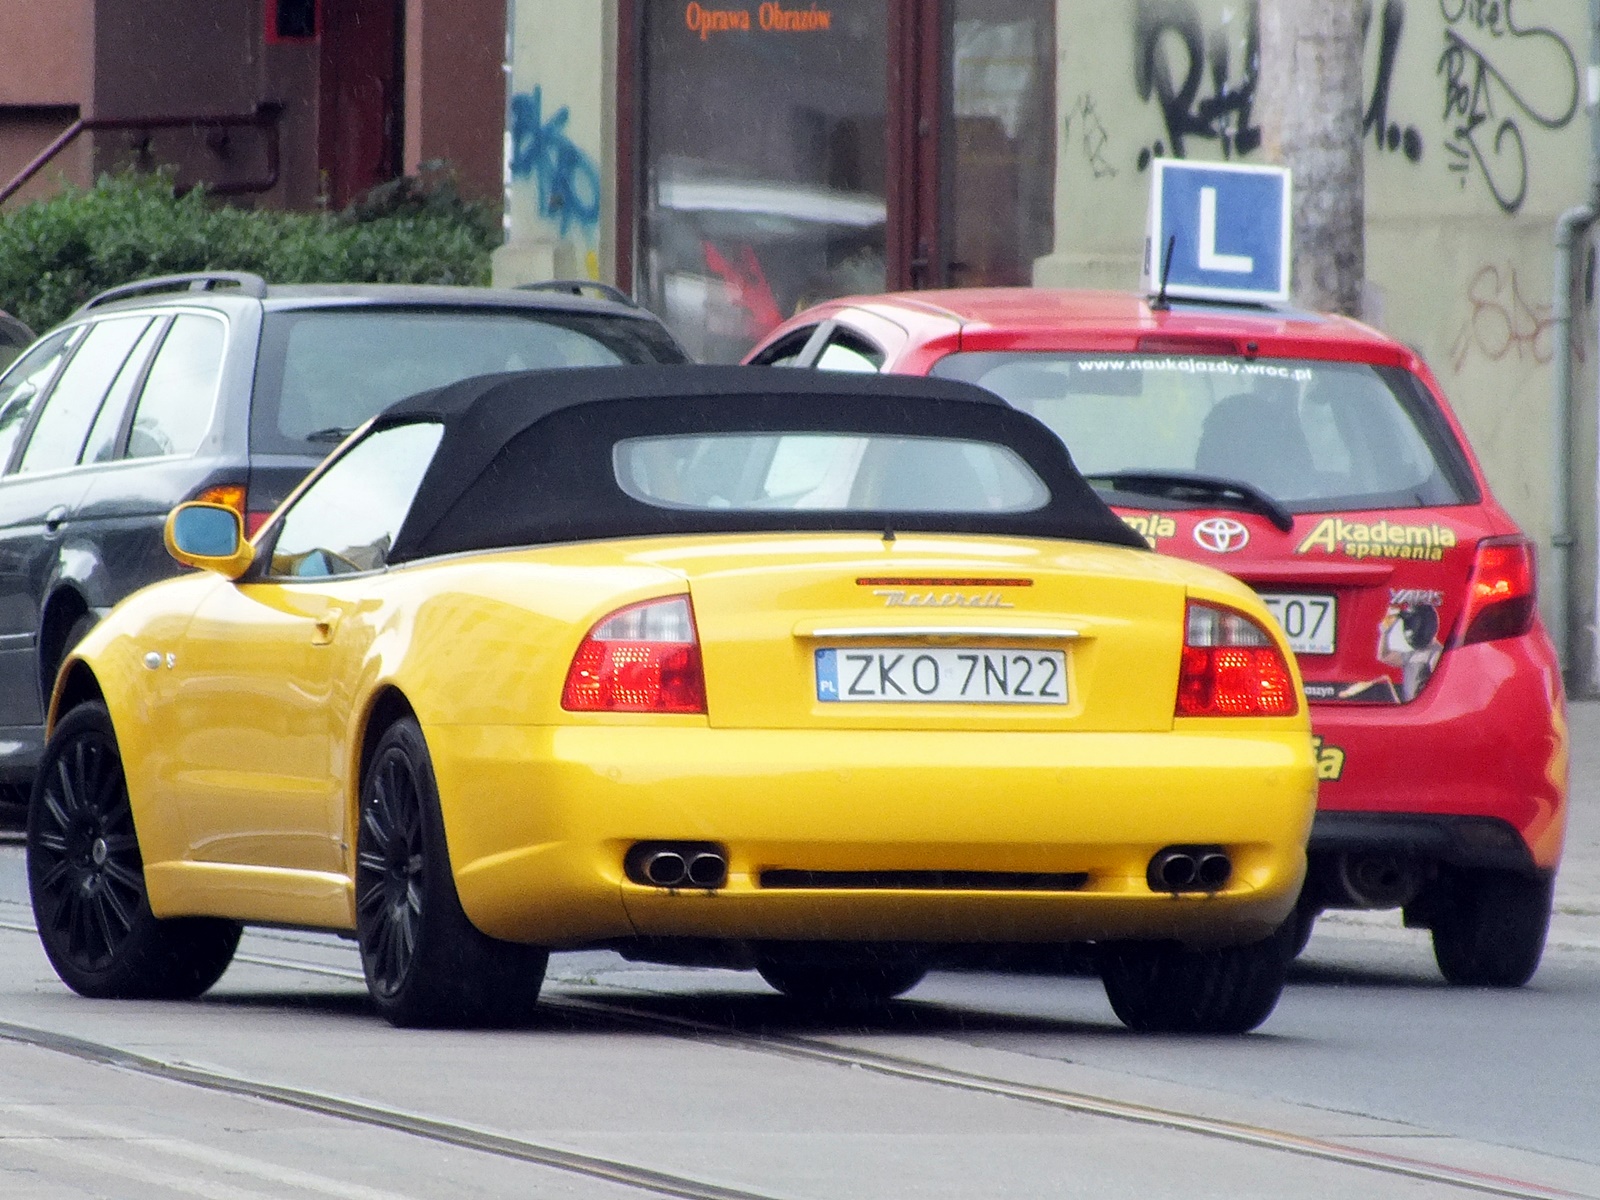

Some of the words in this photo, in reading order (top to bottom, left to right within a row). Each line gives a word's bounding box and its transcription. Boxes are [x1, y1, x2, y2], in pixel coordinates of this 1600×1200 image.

[685, 1, 749, 41] Oprawa
[1199, 186, 1253, 272] L
[1077, 358, 1313, 382] www.naukajazdy.wroc.pl
[1297, 517, 1457, 554] Akademia
[1345, 543, 1444, 561] spawania
[820, 680, 837, 693] PL
[957, 654, 1060, 697] 7N22
